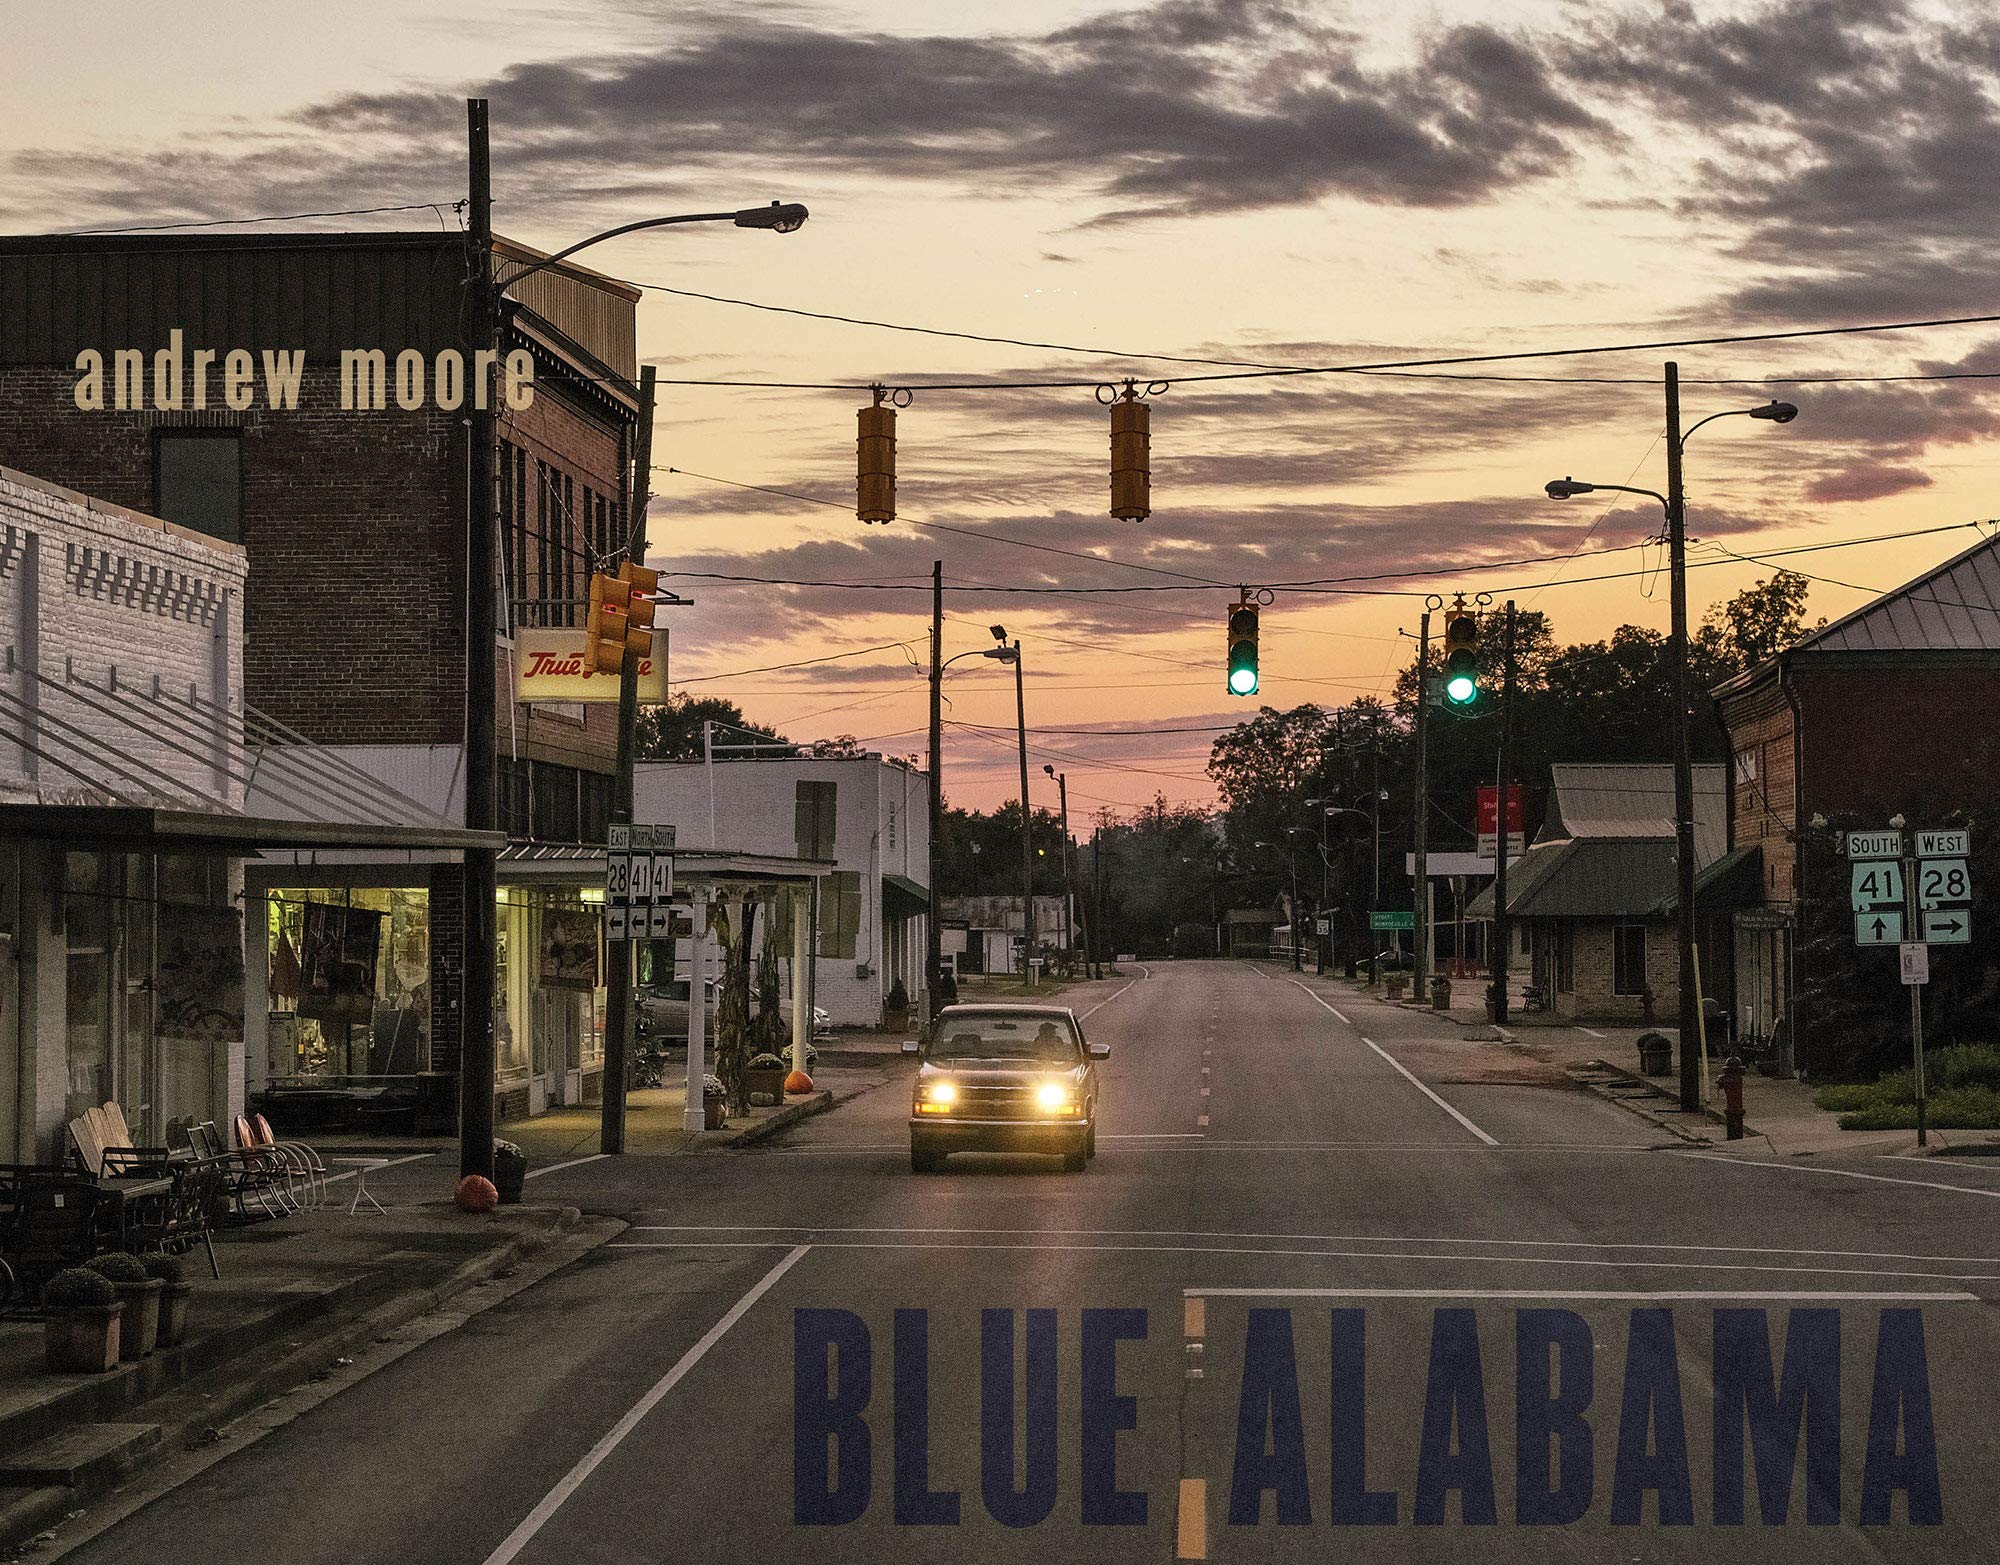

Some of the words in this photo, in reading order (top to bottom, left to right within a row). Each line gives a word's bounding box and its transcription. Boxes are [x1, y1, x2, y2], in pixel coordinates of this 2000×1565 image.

[523, 651, 581, 678] True
[610, 828, 628, 846] EAST
[631, 829, 652, 846] NORTH
[654, 829, 675, 847] SOUTH
[1851, 837, 1899, 854] SOUTH
[1922, 835, 1962, 852] WEST
[608, 864, 627, 893] 28
[631, 864, 647, 893] 41
[654, 864, 669, 893] 41
[1858, 870, 1893, 899] 41
[1924, 868, 1966, 898] 28
